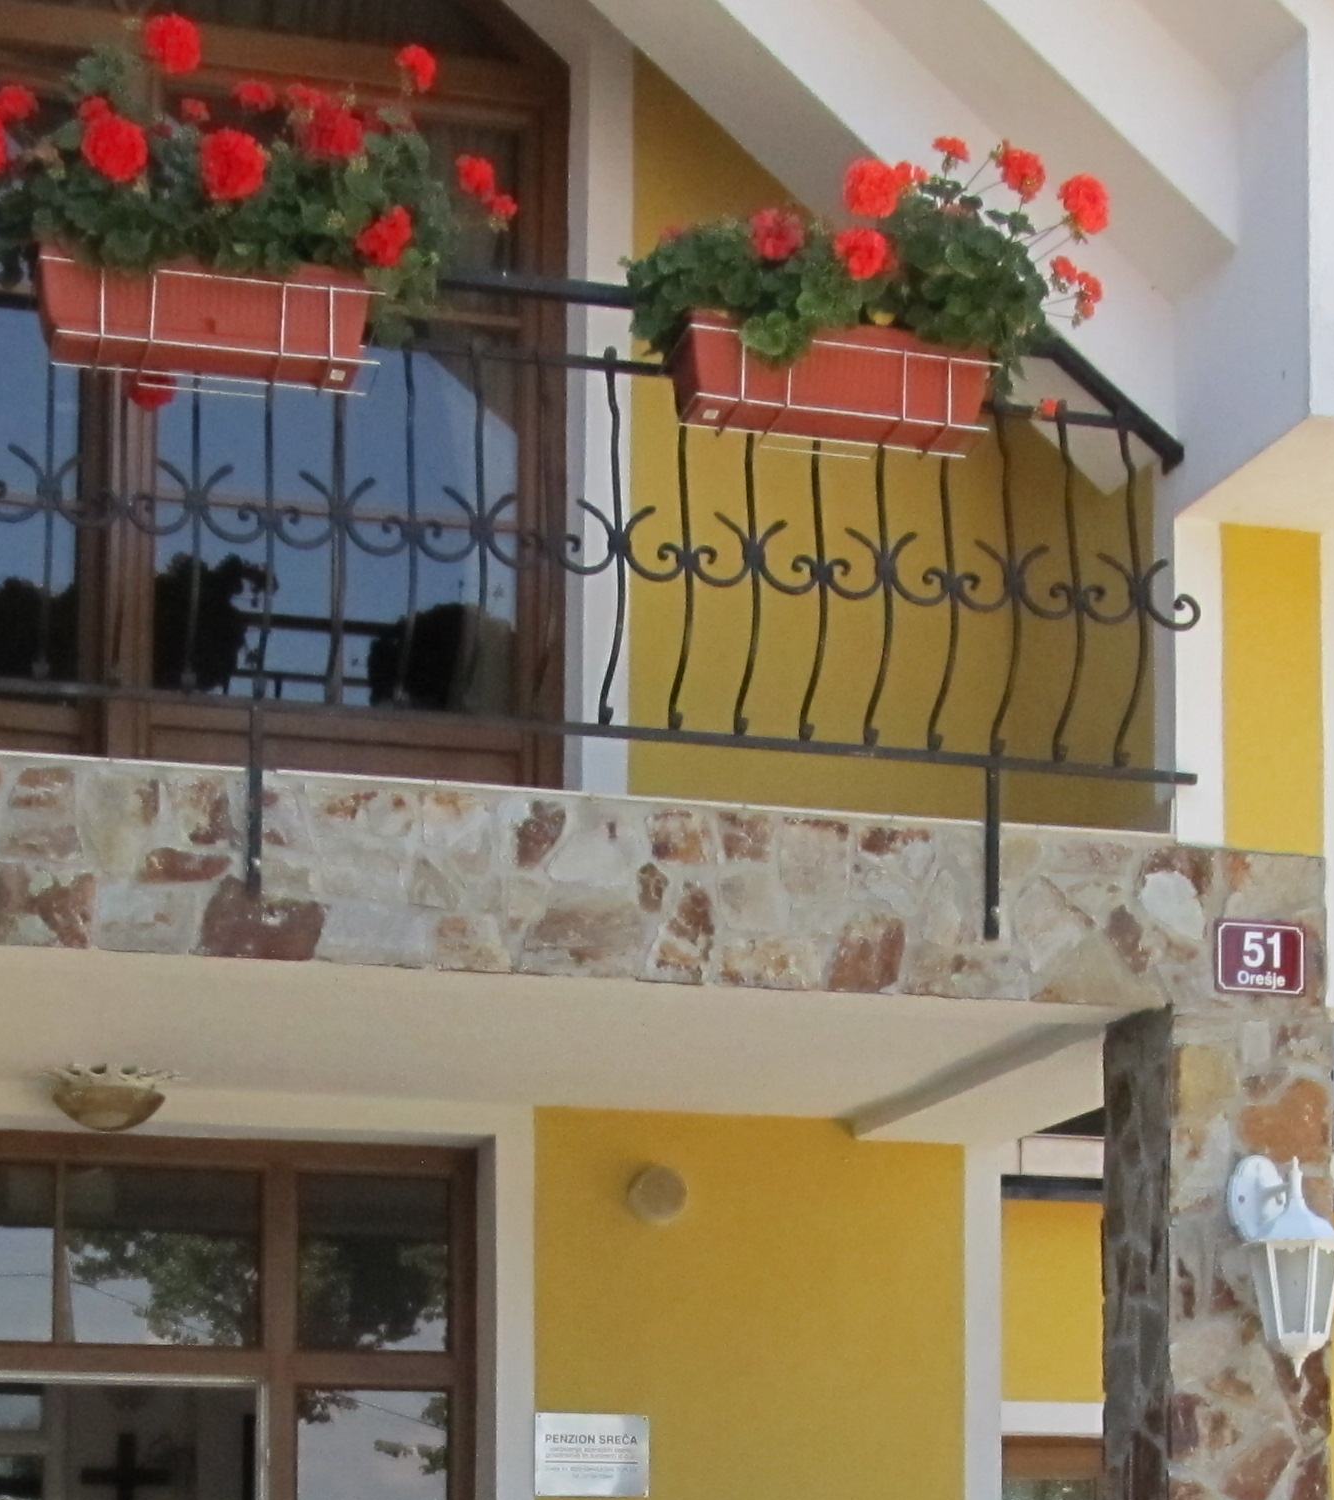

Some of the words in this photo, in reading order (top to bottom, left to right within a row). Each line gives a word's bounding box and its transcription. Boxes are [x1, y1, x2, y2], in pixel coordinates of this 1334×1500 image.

[1242, 930, 1282, 968] 51
[1237, 970, 1286, 990] Orešje
[544, 1433, 596, 1445] PENZION
[598, 1433, 639, 1446] SREČA
